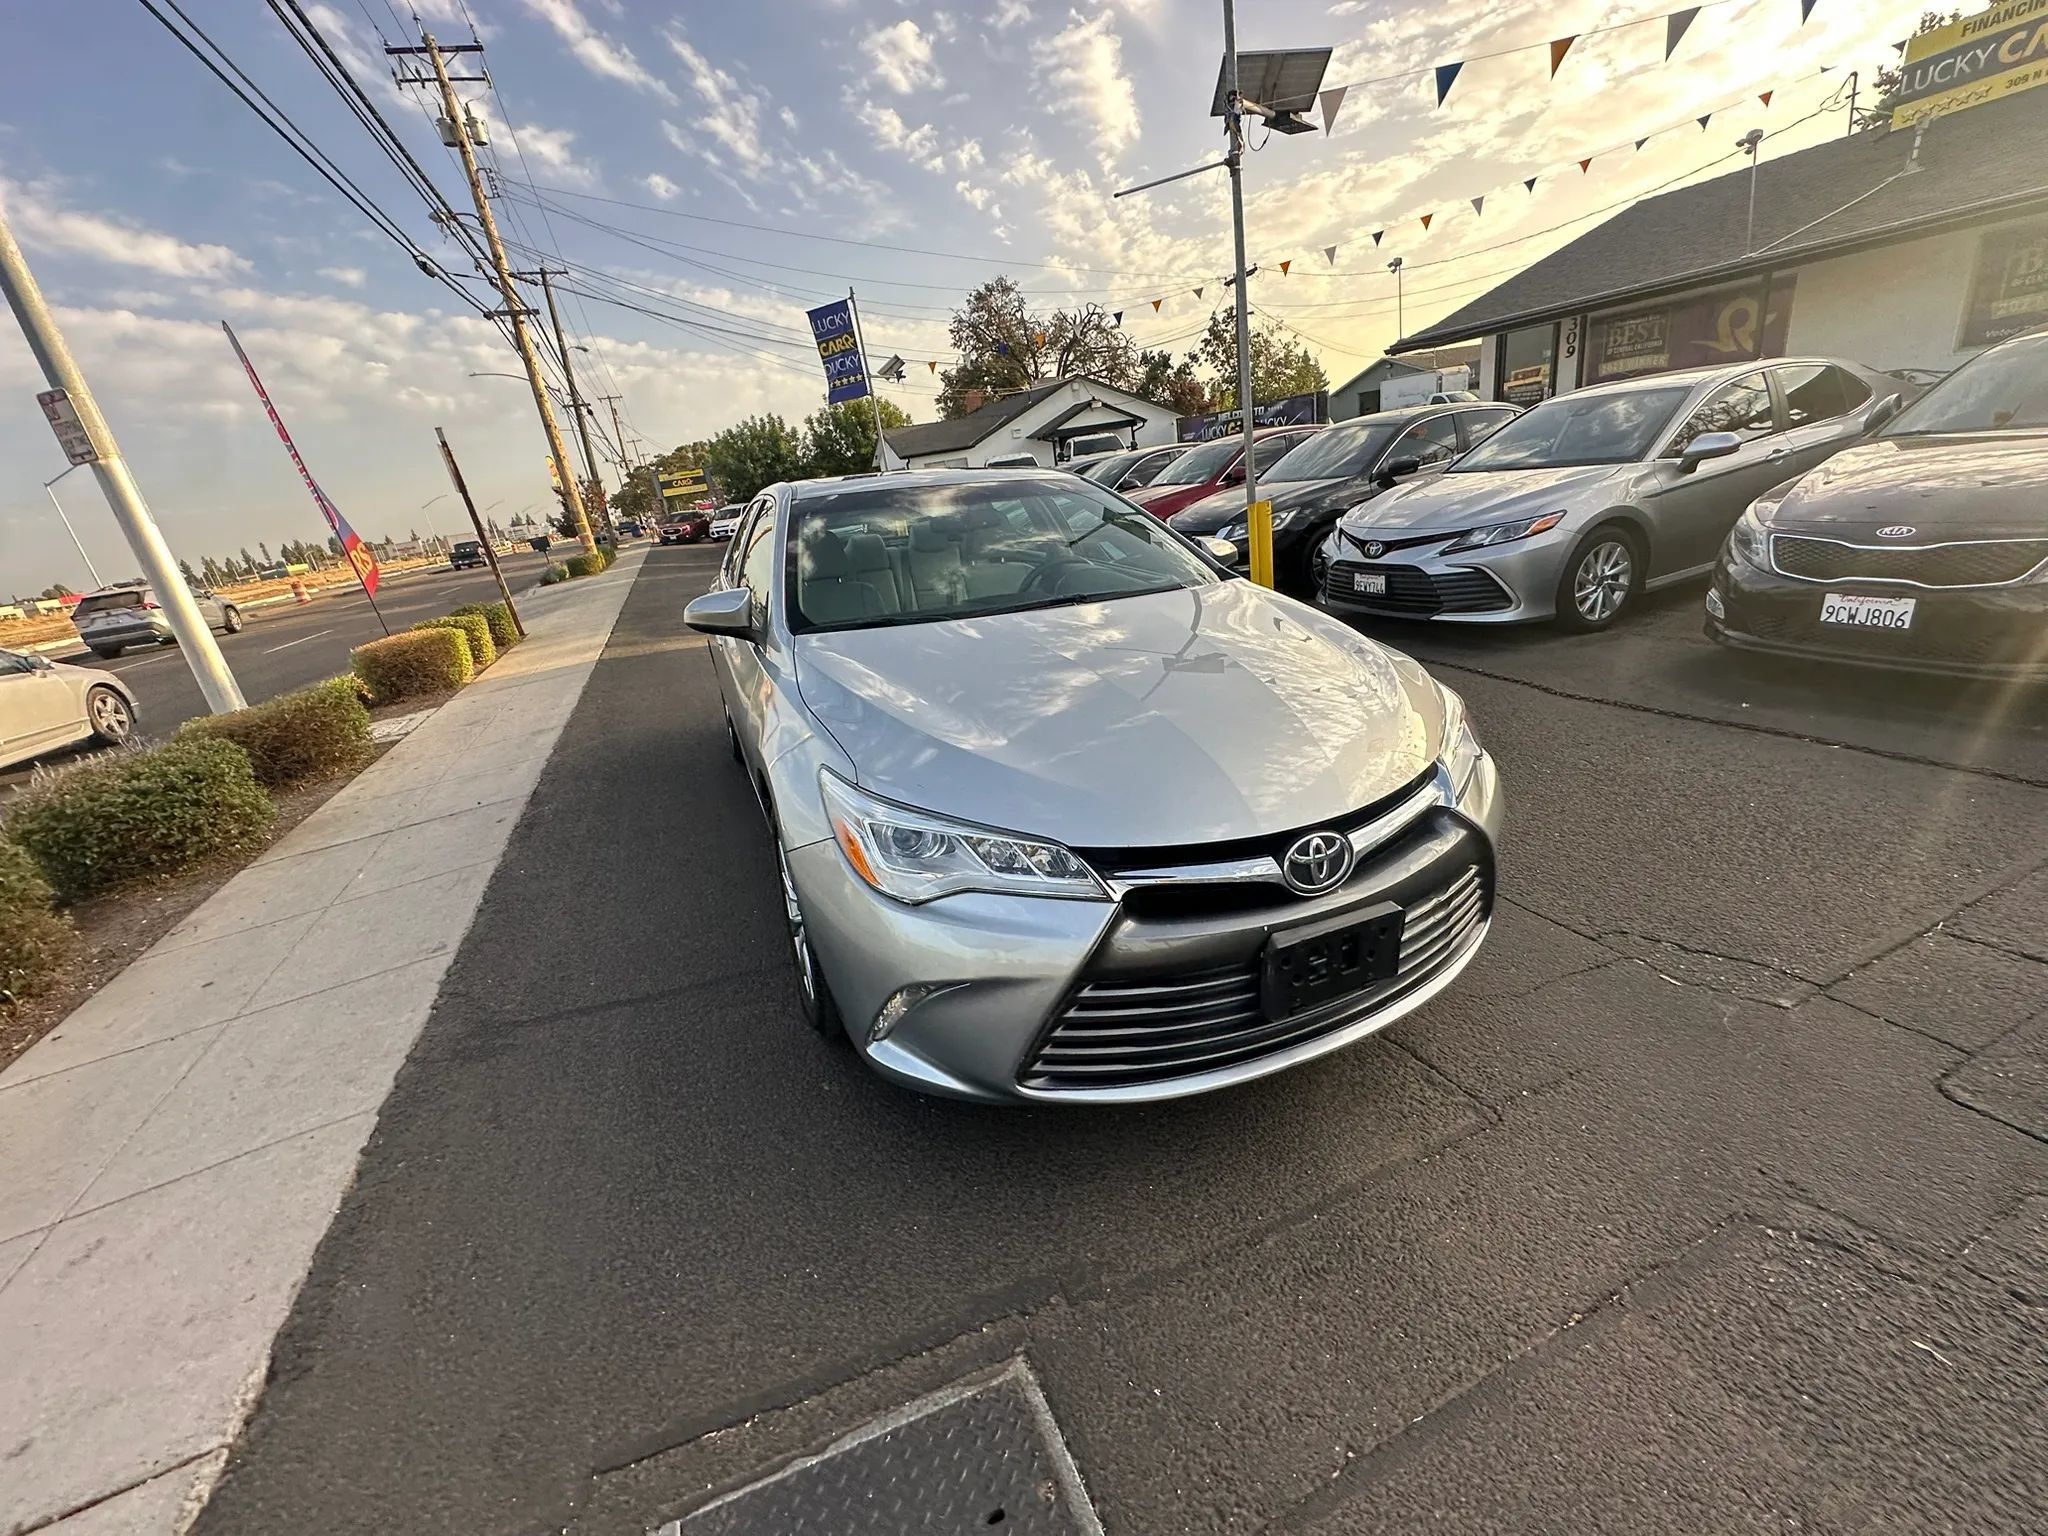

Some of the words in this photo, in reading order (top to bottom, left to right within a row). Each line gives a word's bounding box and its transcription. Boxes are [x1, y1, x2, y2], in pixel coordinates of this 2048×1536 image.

[1900, 43, 1997, 96] LUCKY
[2005, 74, 2029, 89] 309
[2033, 69, 2042, 80] N
[811, 311, 849, 334] LUCKY
[1565, 317, 1578, 358] 309
[1607, 319, 1666, 348] BEST
[1254, 405, 1265, 416] TO
[1201, 424, 1227, 441] LUCKY
[1880, 527, 1908, 536] KIA
[1838, 593, 1900, 606] California
[1824, 604, 1909, 629] 9CWJ806
